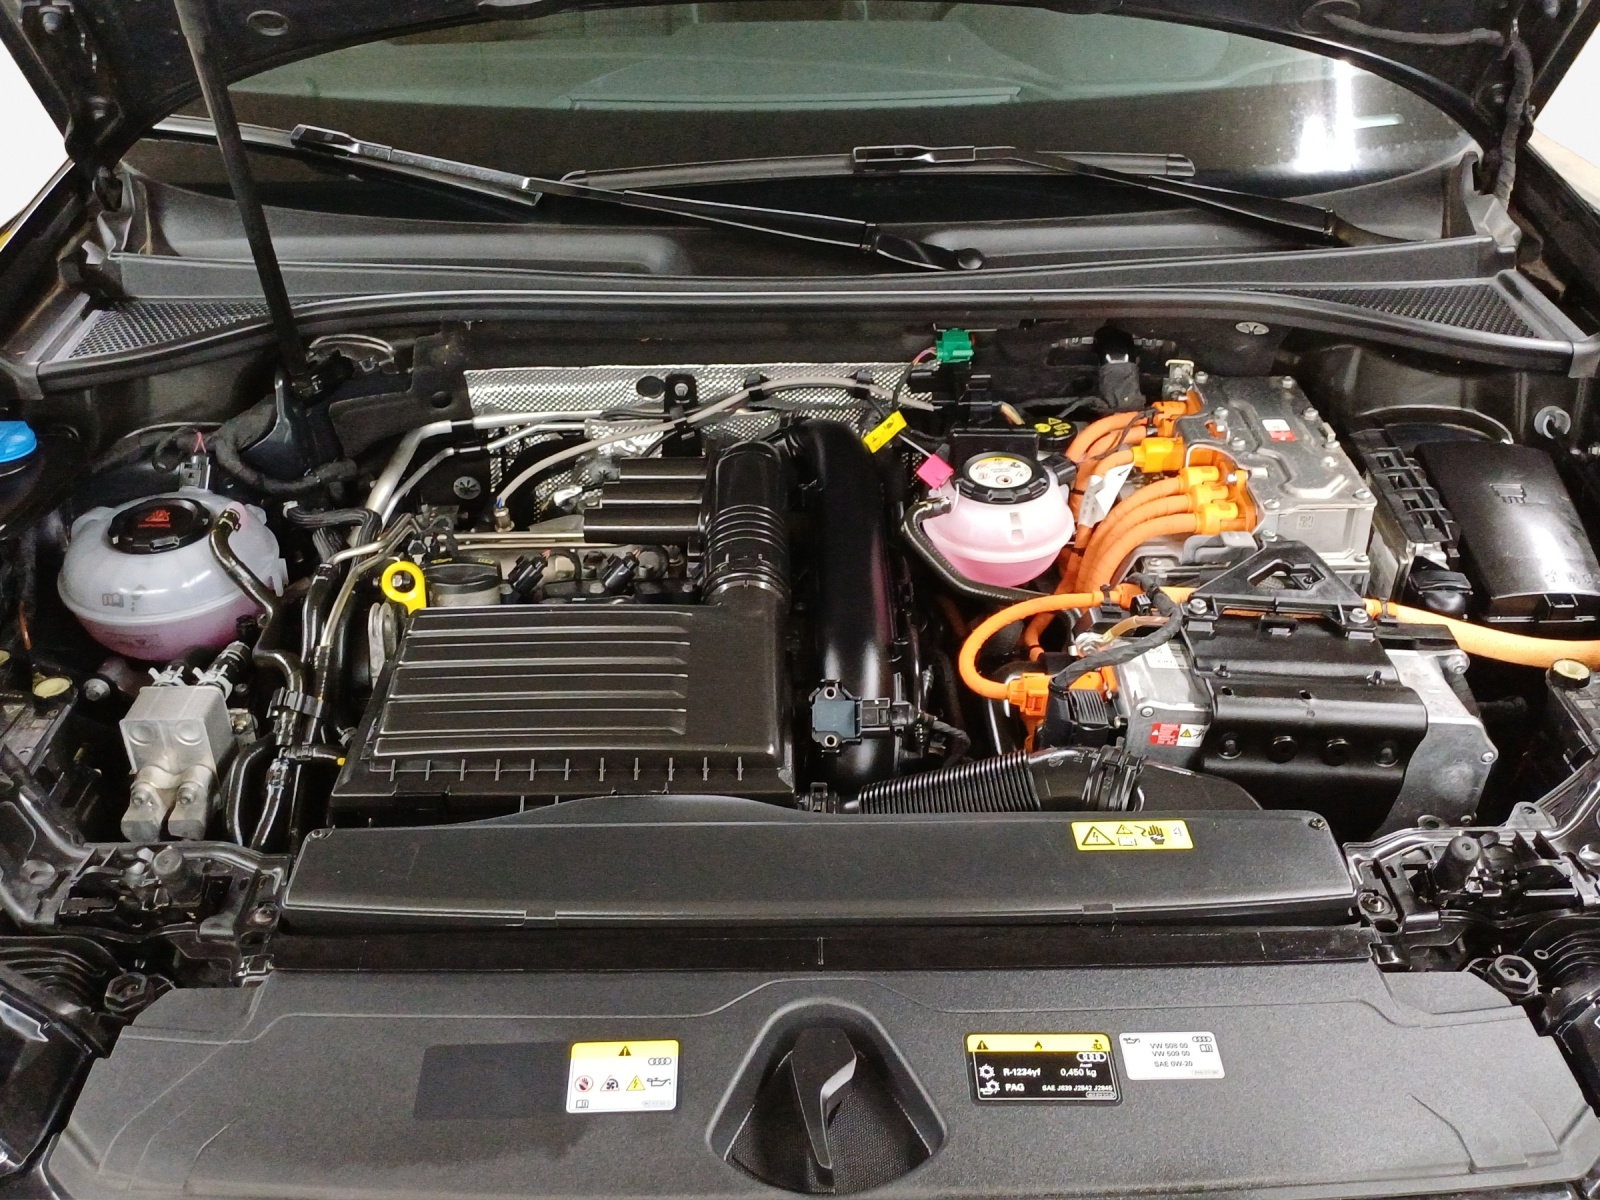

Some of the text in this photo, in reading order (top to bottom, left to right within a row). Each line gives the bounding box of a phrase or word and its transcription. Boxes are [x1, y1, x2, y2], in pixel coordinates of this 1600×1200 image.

[1060, 1067, 1084, 1077] 0,450
[1085, 1067, 1097, 1078] kg
[1004, 1082, 1025, 1092] PAG
[1041, 1084, 1056, 1092] SAE
